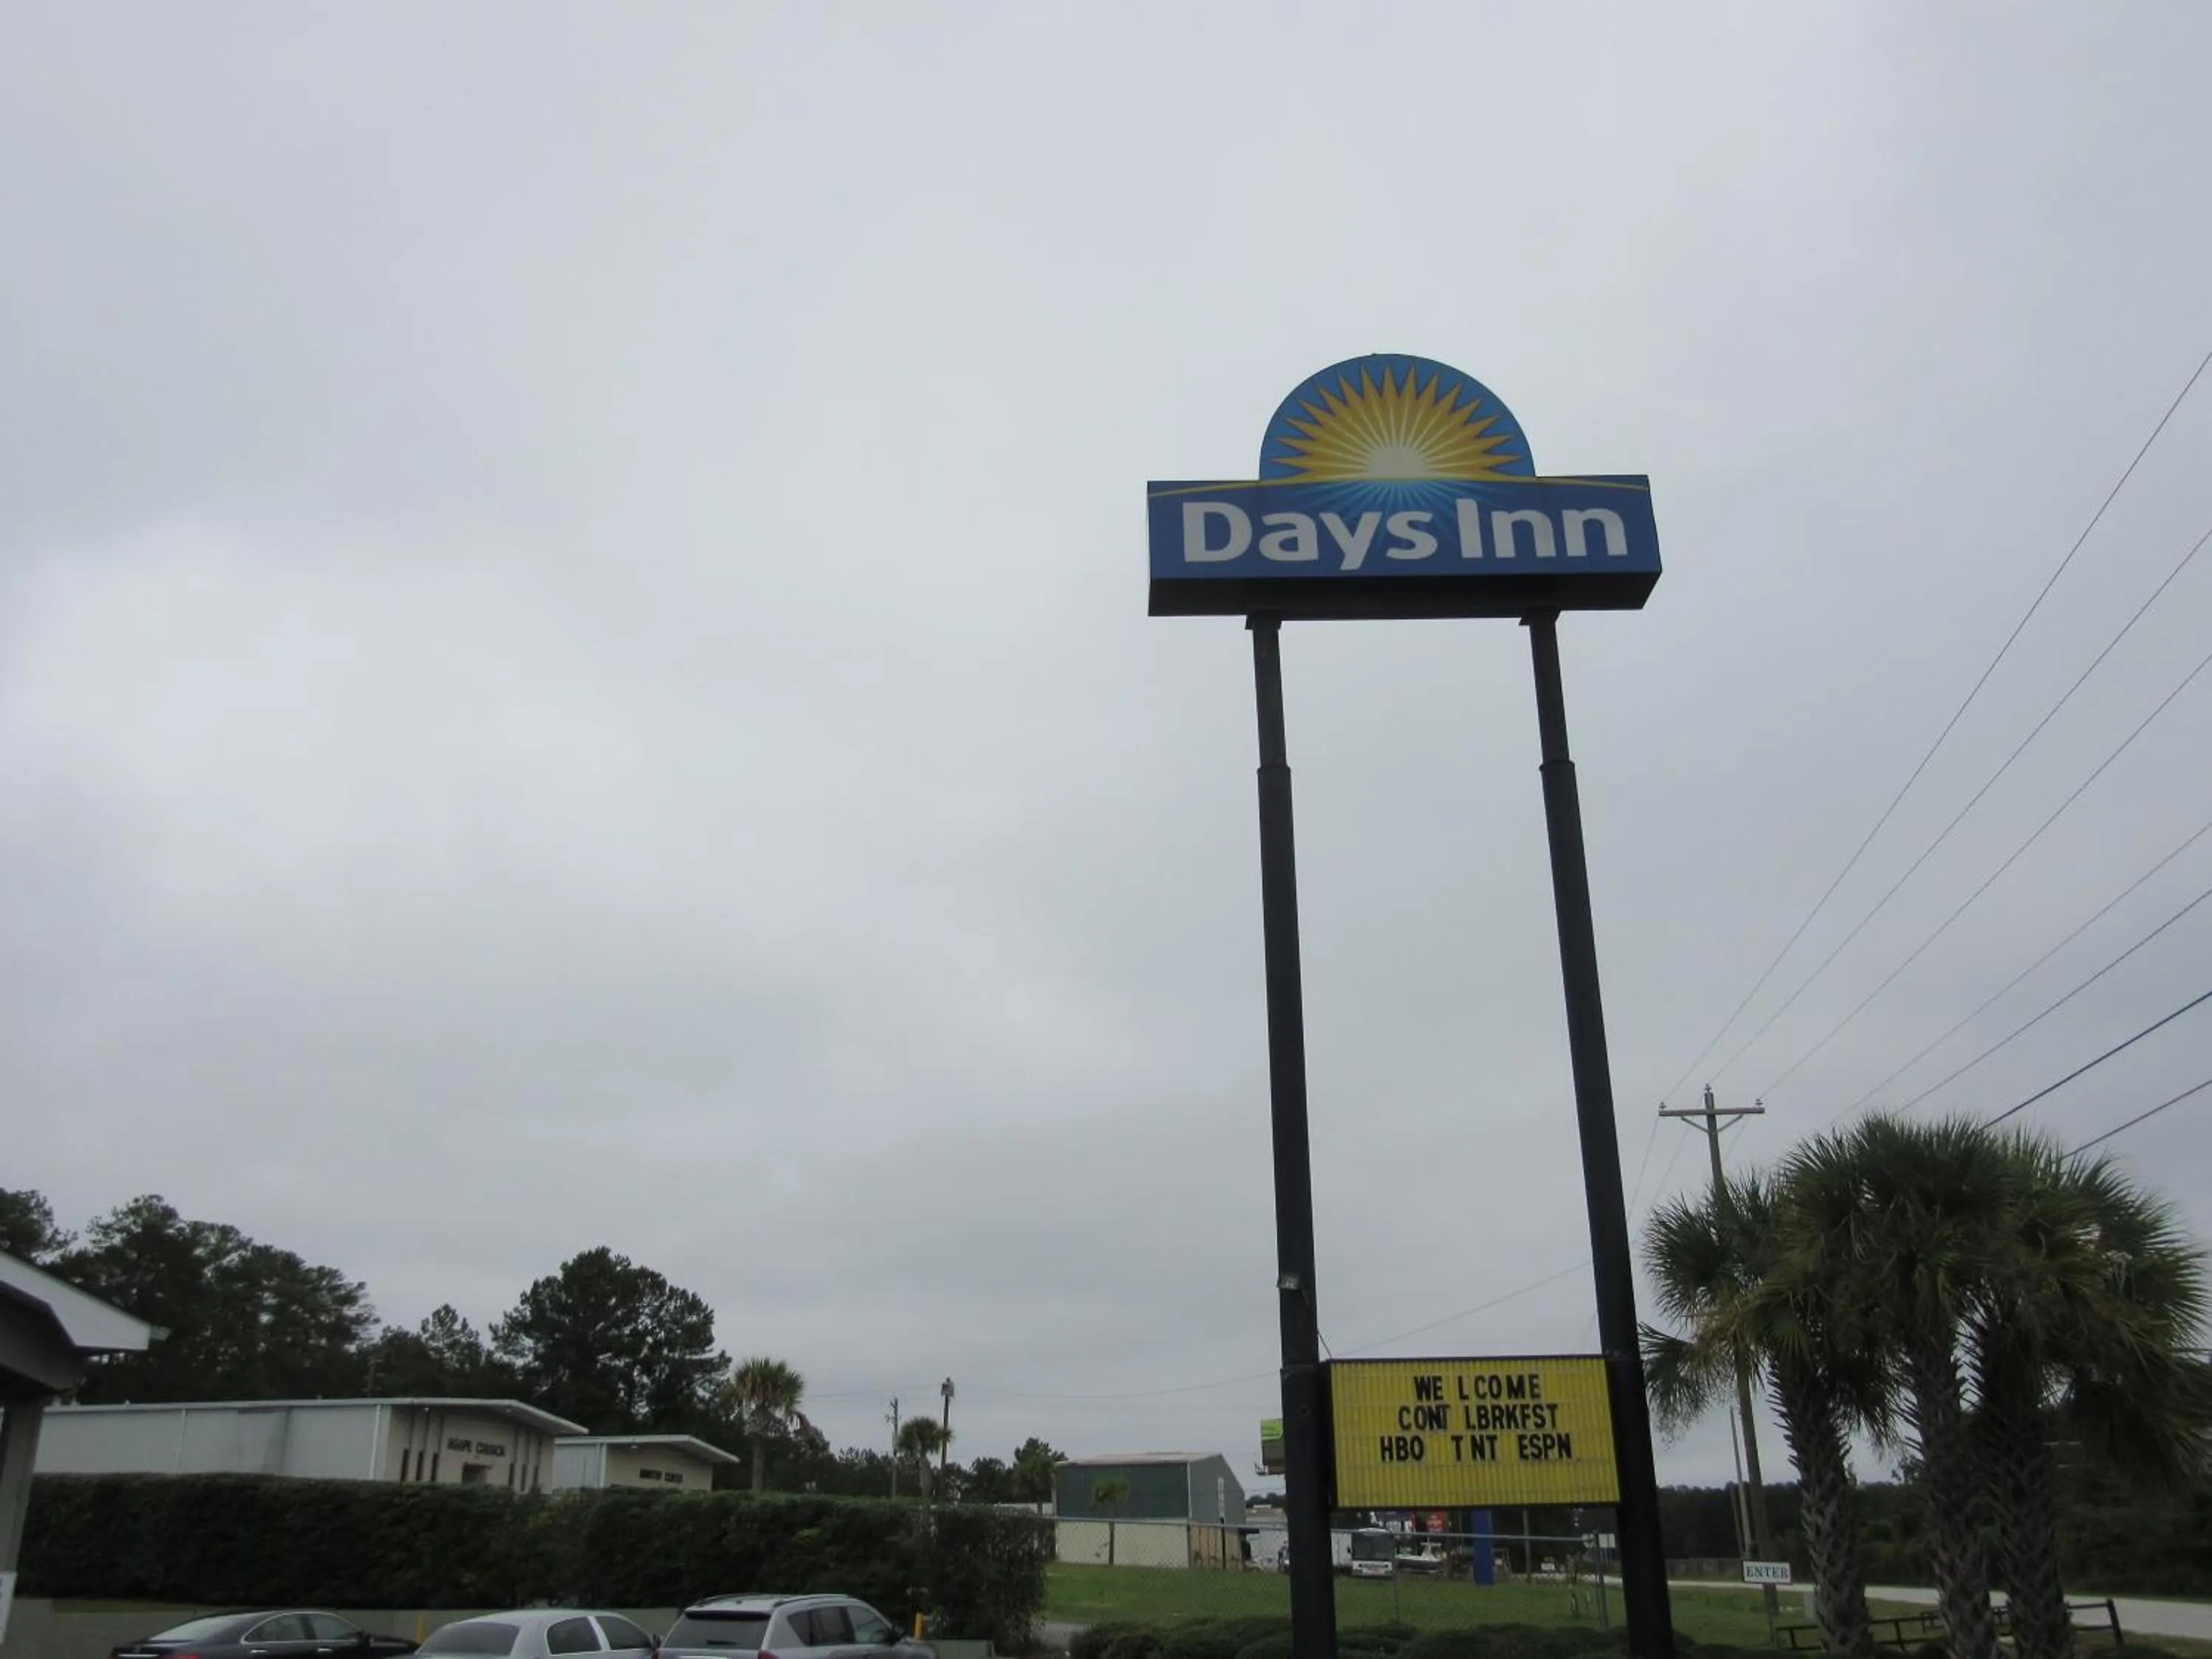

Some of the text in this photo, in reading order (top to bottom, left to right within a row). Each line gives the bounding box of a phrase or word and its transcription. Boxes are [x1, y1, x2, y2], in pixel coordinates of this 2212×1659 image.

[1182, 498, 1628, 571] Days Inn
[1380, 1433, 1572, 1461] HBO TNT ESPN
[1745, 1565, 1789, 1580] ENTER
